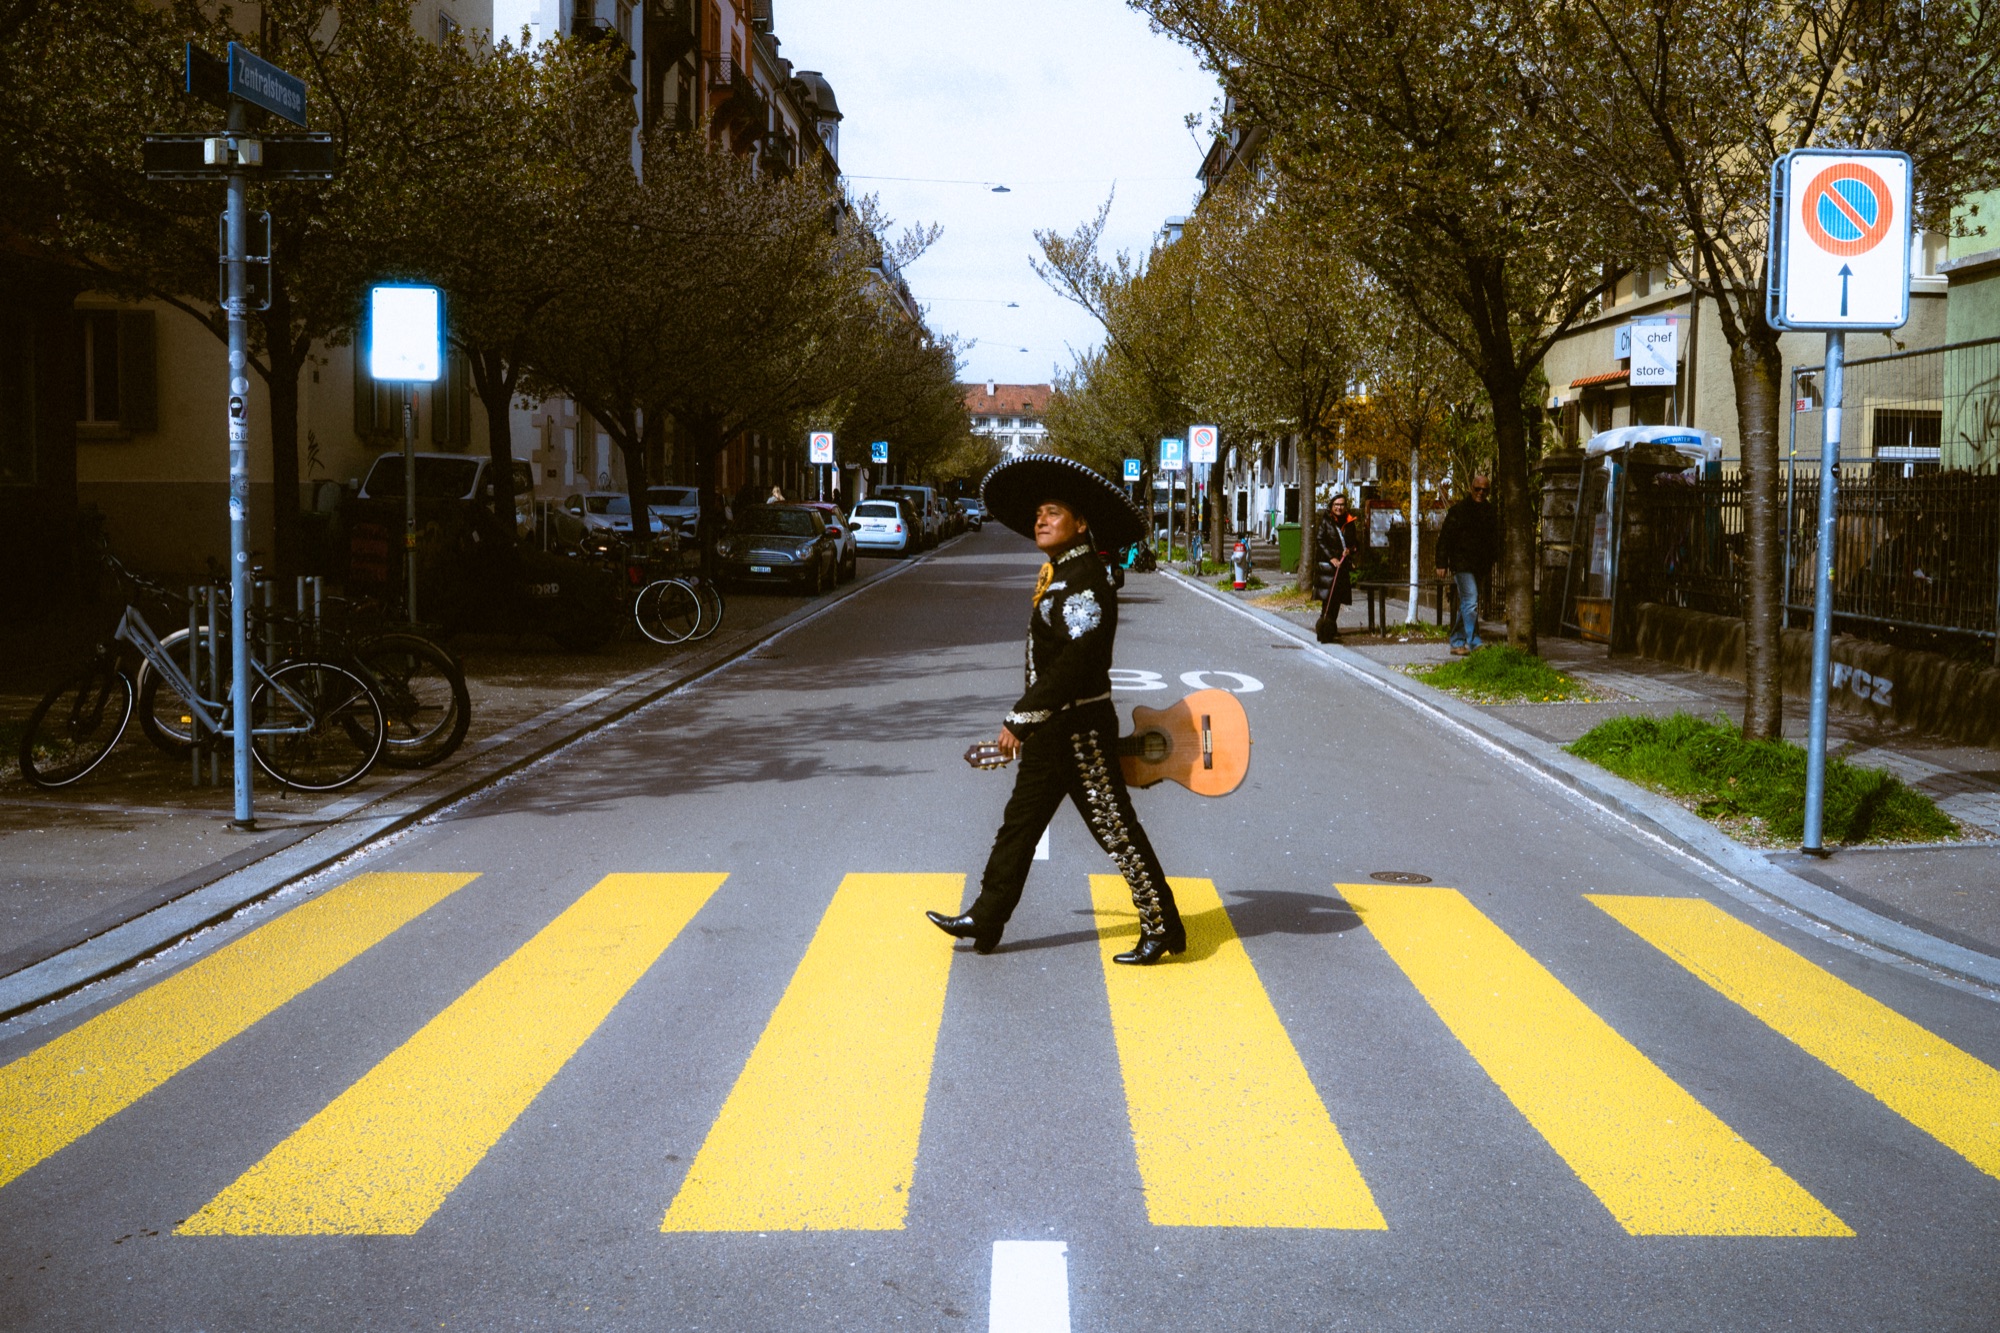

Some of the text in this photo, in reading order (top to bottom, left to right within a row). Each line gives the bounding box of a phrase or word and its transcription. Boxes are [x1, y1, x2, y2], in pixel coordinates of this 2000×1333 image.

[238, 57, 301, 112] Zentralstrasse
[1620, 331, 1631, 351] Ch
[1647, 331, 1672, 343] chef
[1636, 366, 1665, 376] store
[1107, 669, 1264, 693] 30
[1832, 662, 1894, 707] FCZ
